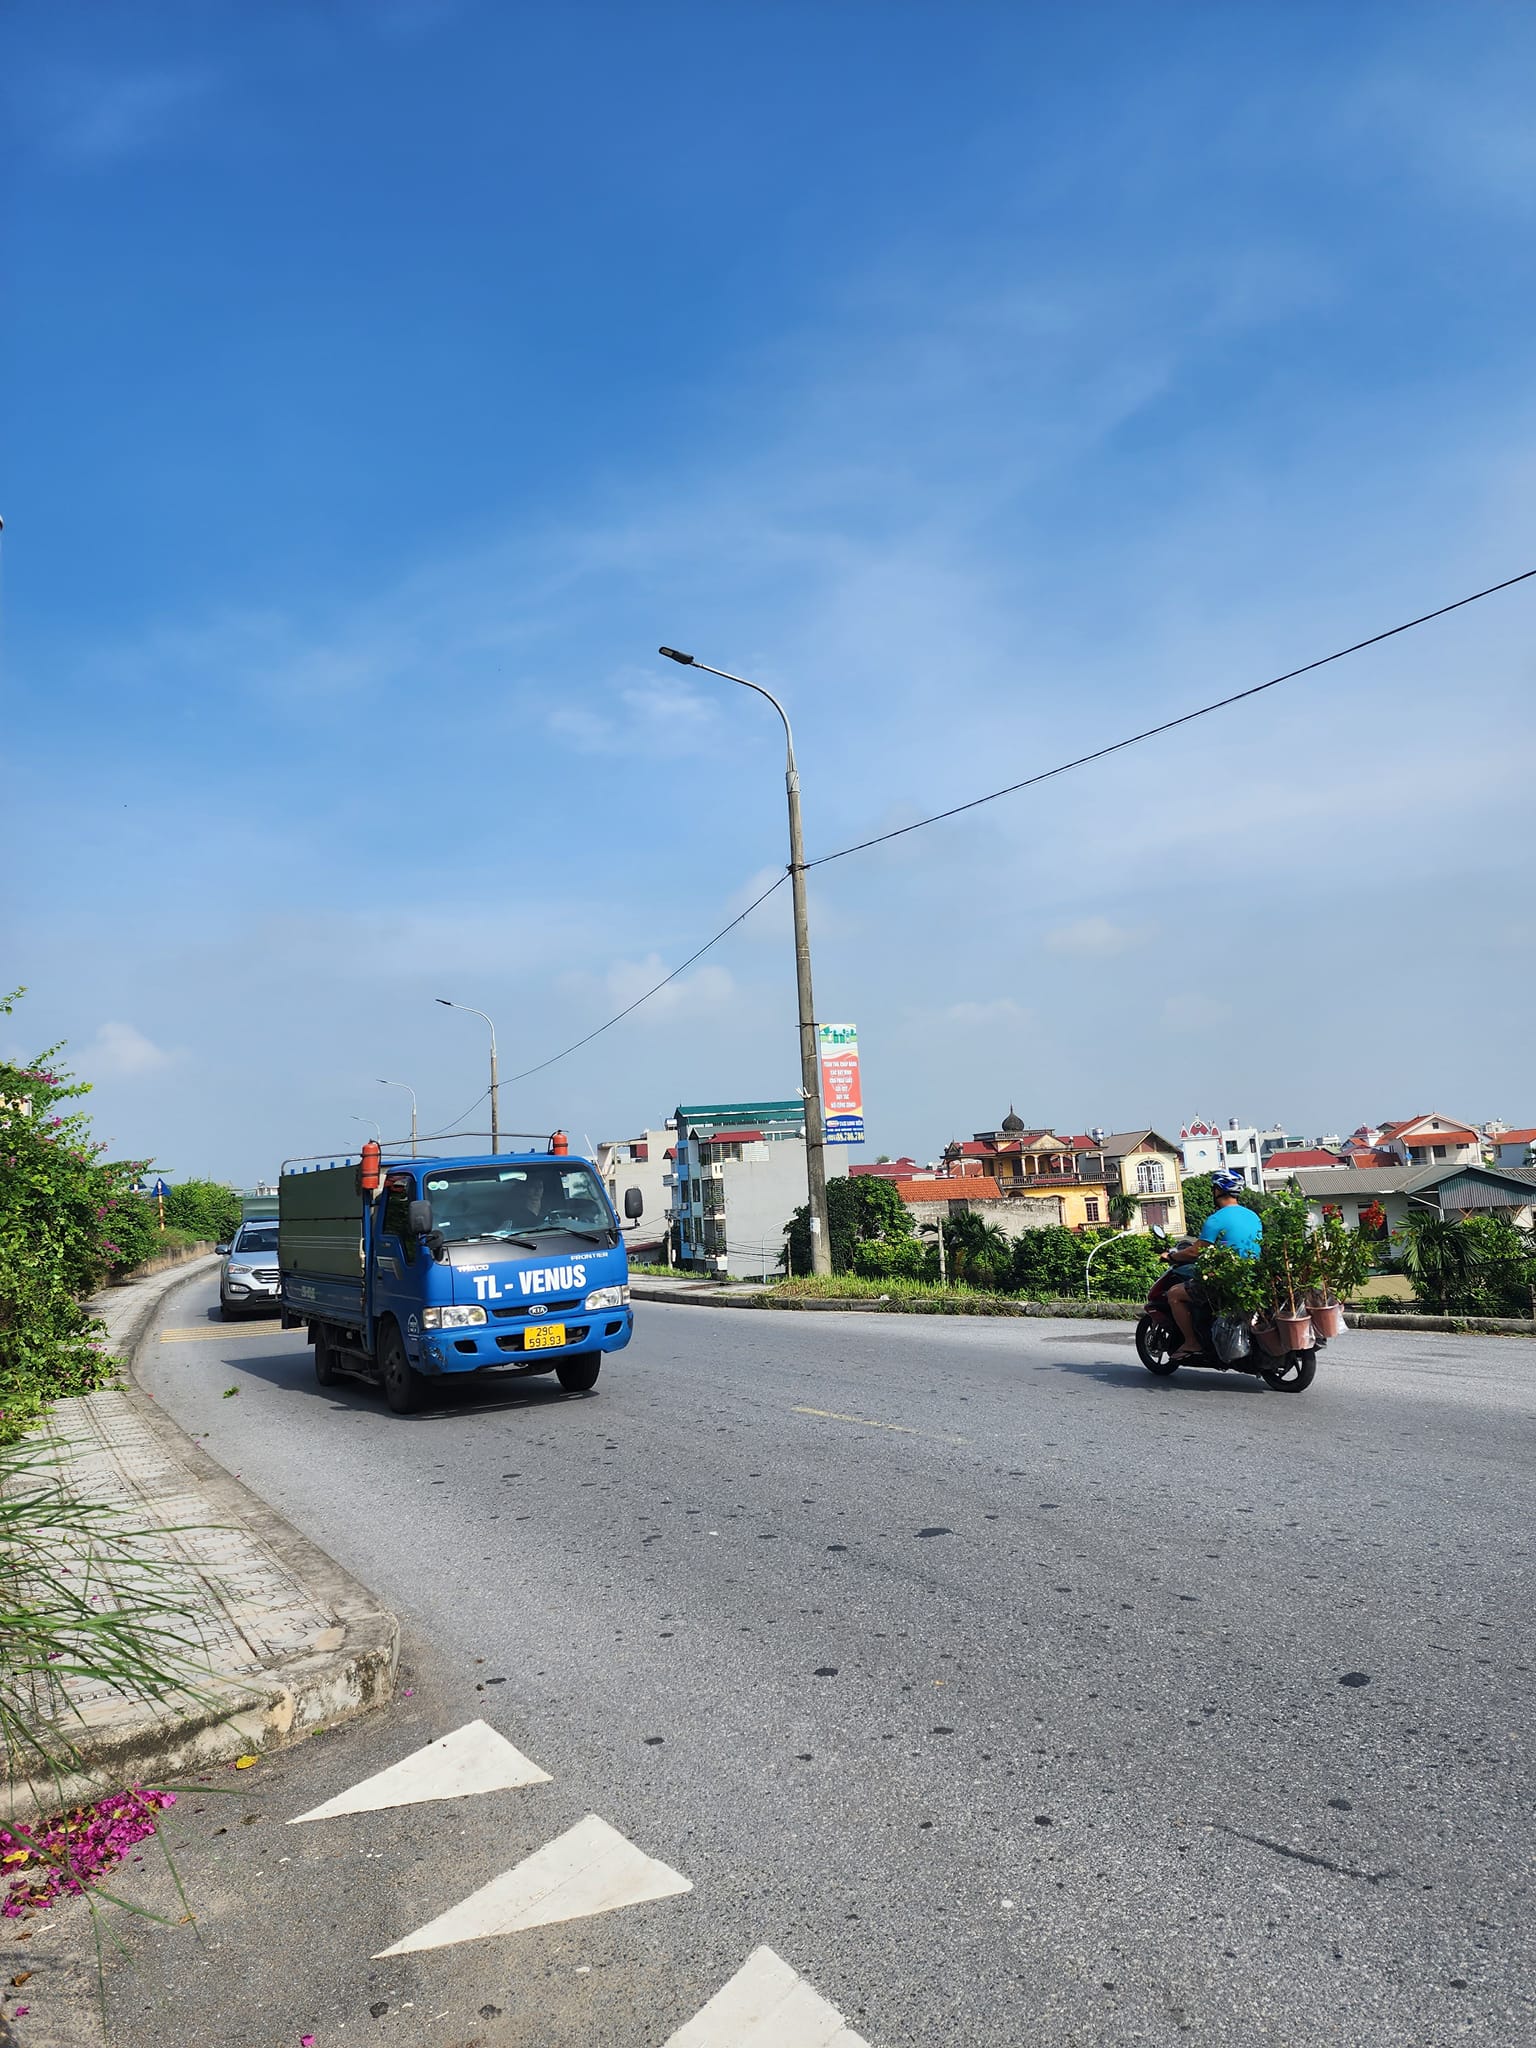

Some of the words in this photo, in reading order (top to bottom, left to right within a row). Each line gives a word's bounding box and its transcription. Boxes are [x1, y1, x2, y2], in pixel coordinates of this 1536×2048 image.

[473, 1275, 503, 1300] TL
[518, 1264, 587, 1295] VENUS
[536, 1326, 554, 1337] 29C
